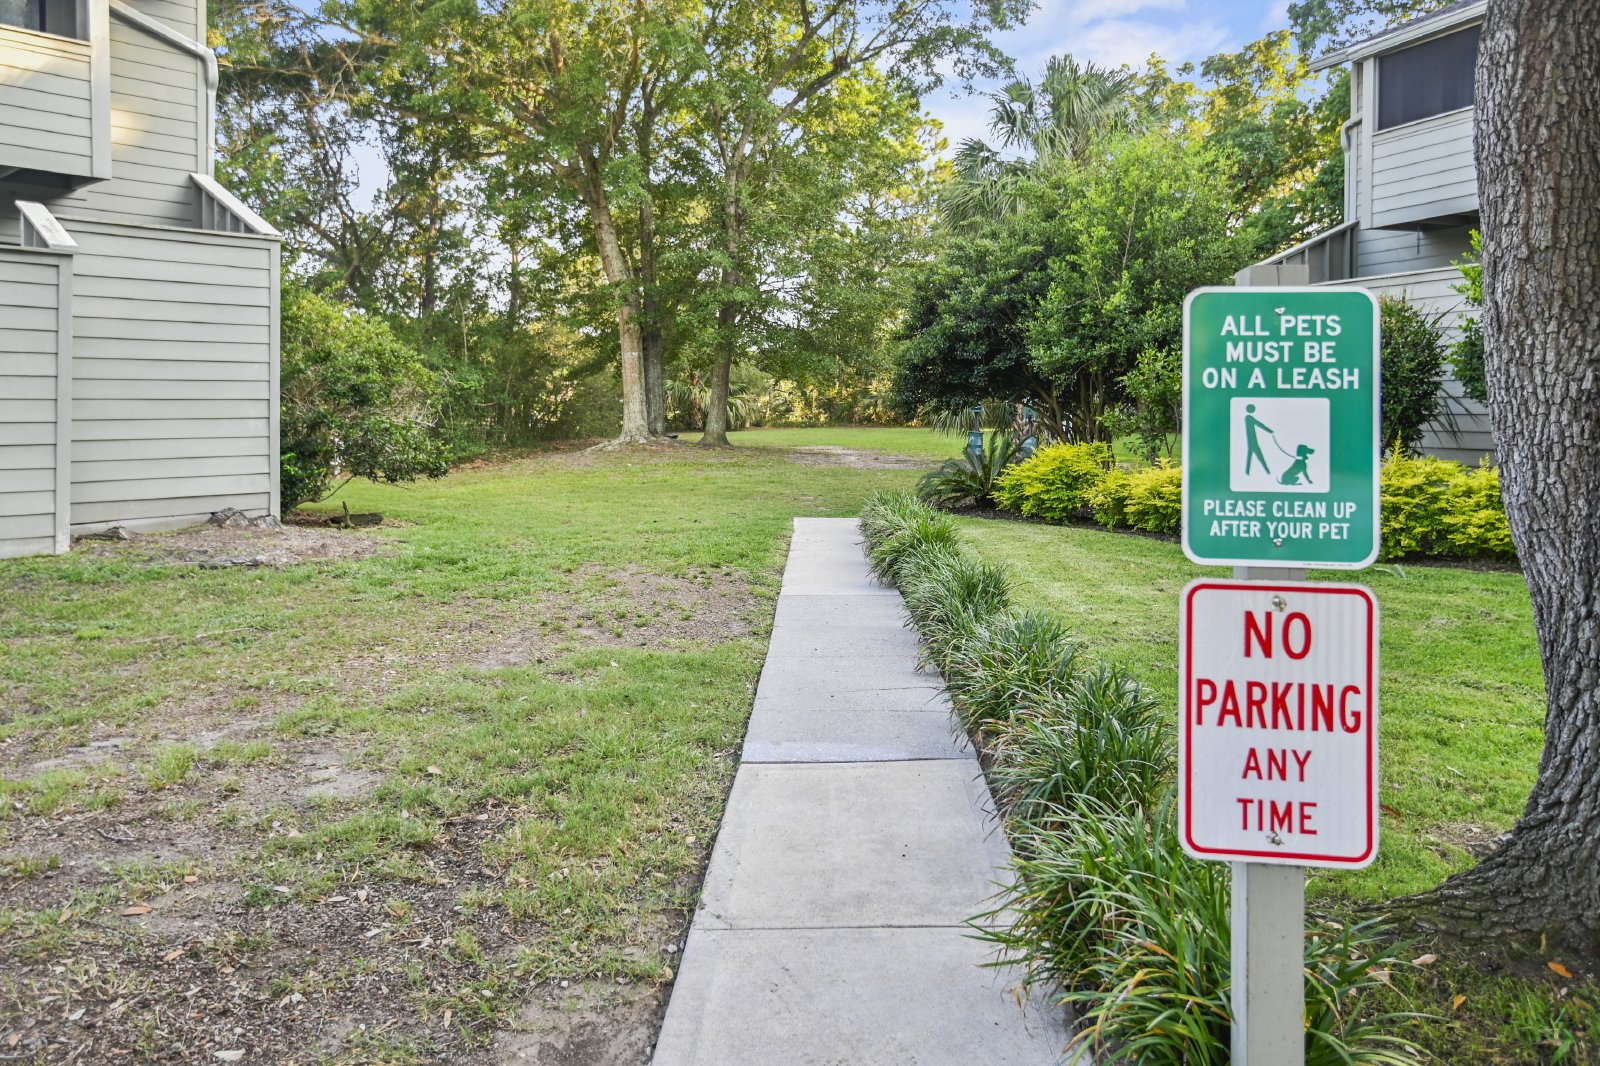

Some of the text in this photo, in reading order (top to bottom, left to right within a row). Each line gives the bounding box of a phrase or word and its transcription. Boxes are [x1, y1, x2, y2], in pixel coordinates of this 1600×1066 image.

[1220, 315, 1342, 336] ALL PETS
[1226, 341, 1336, 363] MUST BE
[1202, 367, 1359, 390] ON A LEASH
[1203, 500, 1357, 519] PLEASE CLEAN UP
[1209, 520, 1350, 540] AFTER YOUR PET
[1243, 610, 1312, 660] NO
[1196, 678, 1361, 733] PARKING
[1242, 747, 1312, 782] ANY
[1236, 797, 1317, 835] TIME
